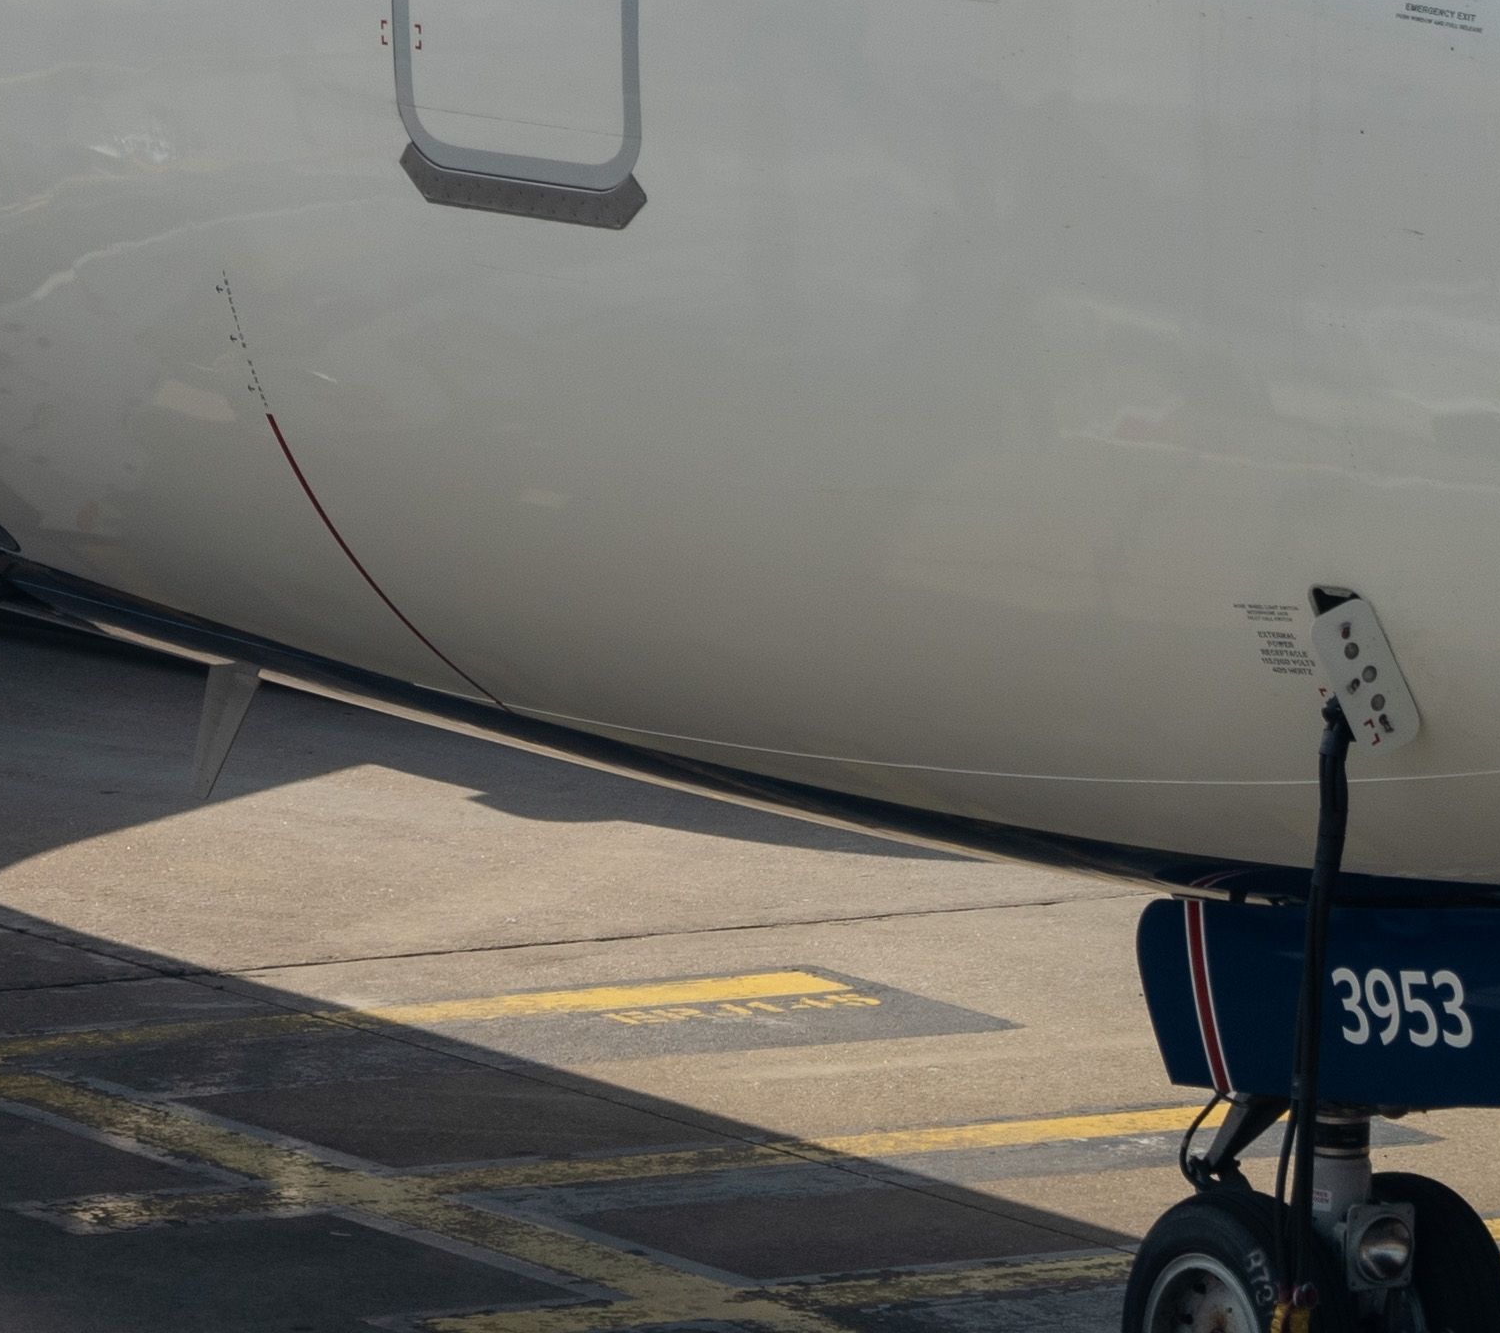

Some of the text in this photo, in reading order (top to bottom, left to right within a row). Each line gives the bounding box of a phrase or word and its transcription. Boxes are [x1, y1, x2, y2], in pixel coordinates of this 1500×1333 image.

[1405, 3, 1476, 21] EMERGENCY EXIT
[1331, 967, 1473, 1049] 3953
